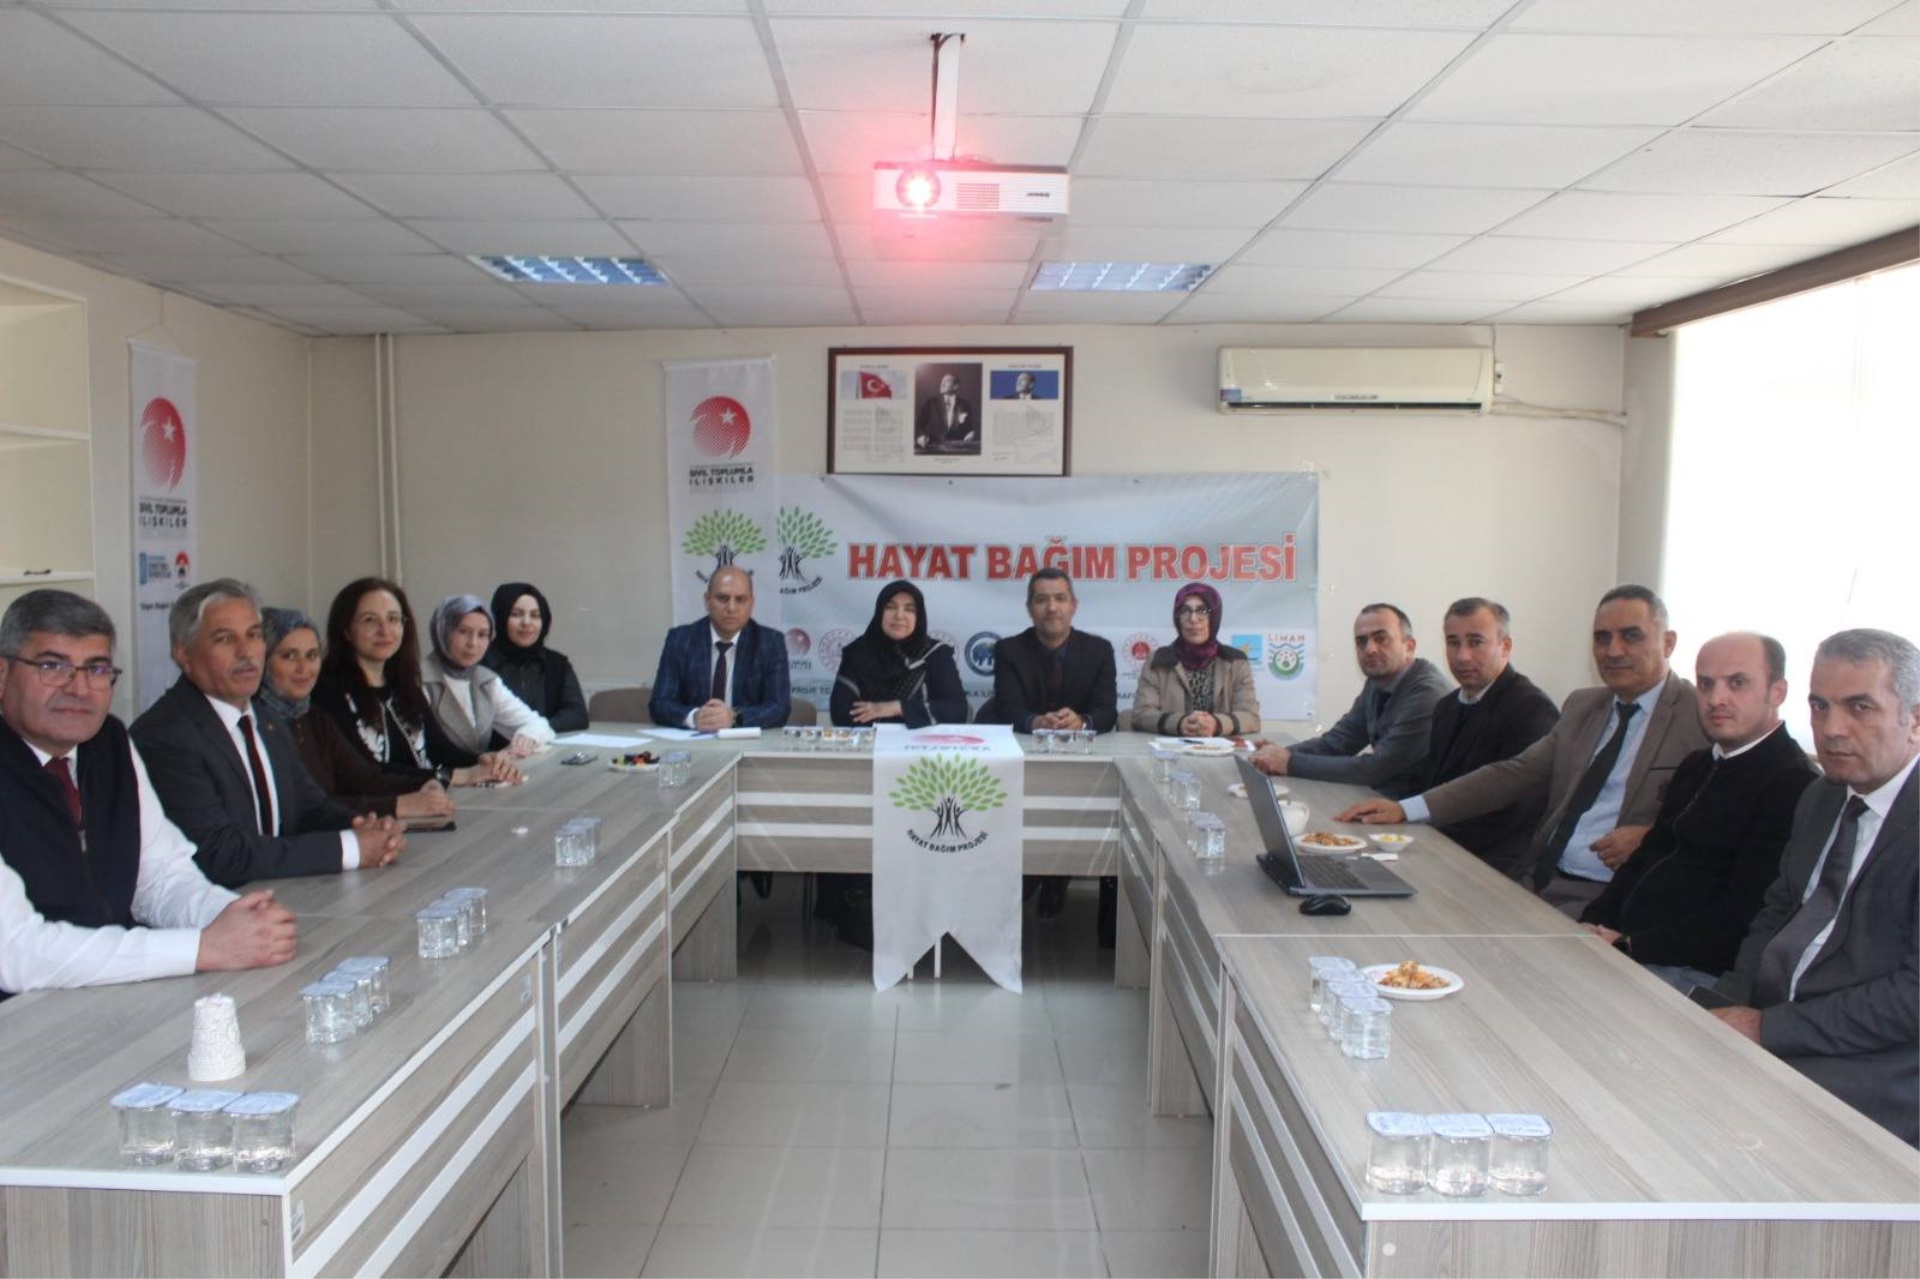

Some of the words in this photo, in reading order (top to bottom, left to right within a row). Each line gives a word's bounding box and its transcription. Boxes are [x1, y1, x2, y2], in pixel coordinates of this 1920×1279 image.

[848, 542, 976, 580] HAYAT
[985, 536, 1116, 580] BAĞIM
[1126, 533, 1297, 581] PROJESİ
[906, 829, 928, 849] HAYAT
[929, 842, 956, 853] BAĞIM
[957, 830, 989, 852] PROJESİ
